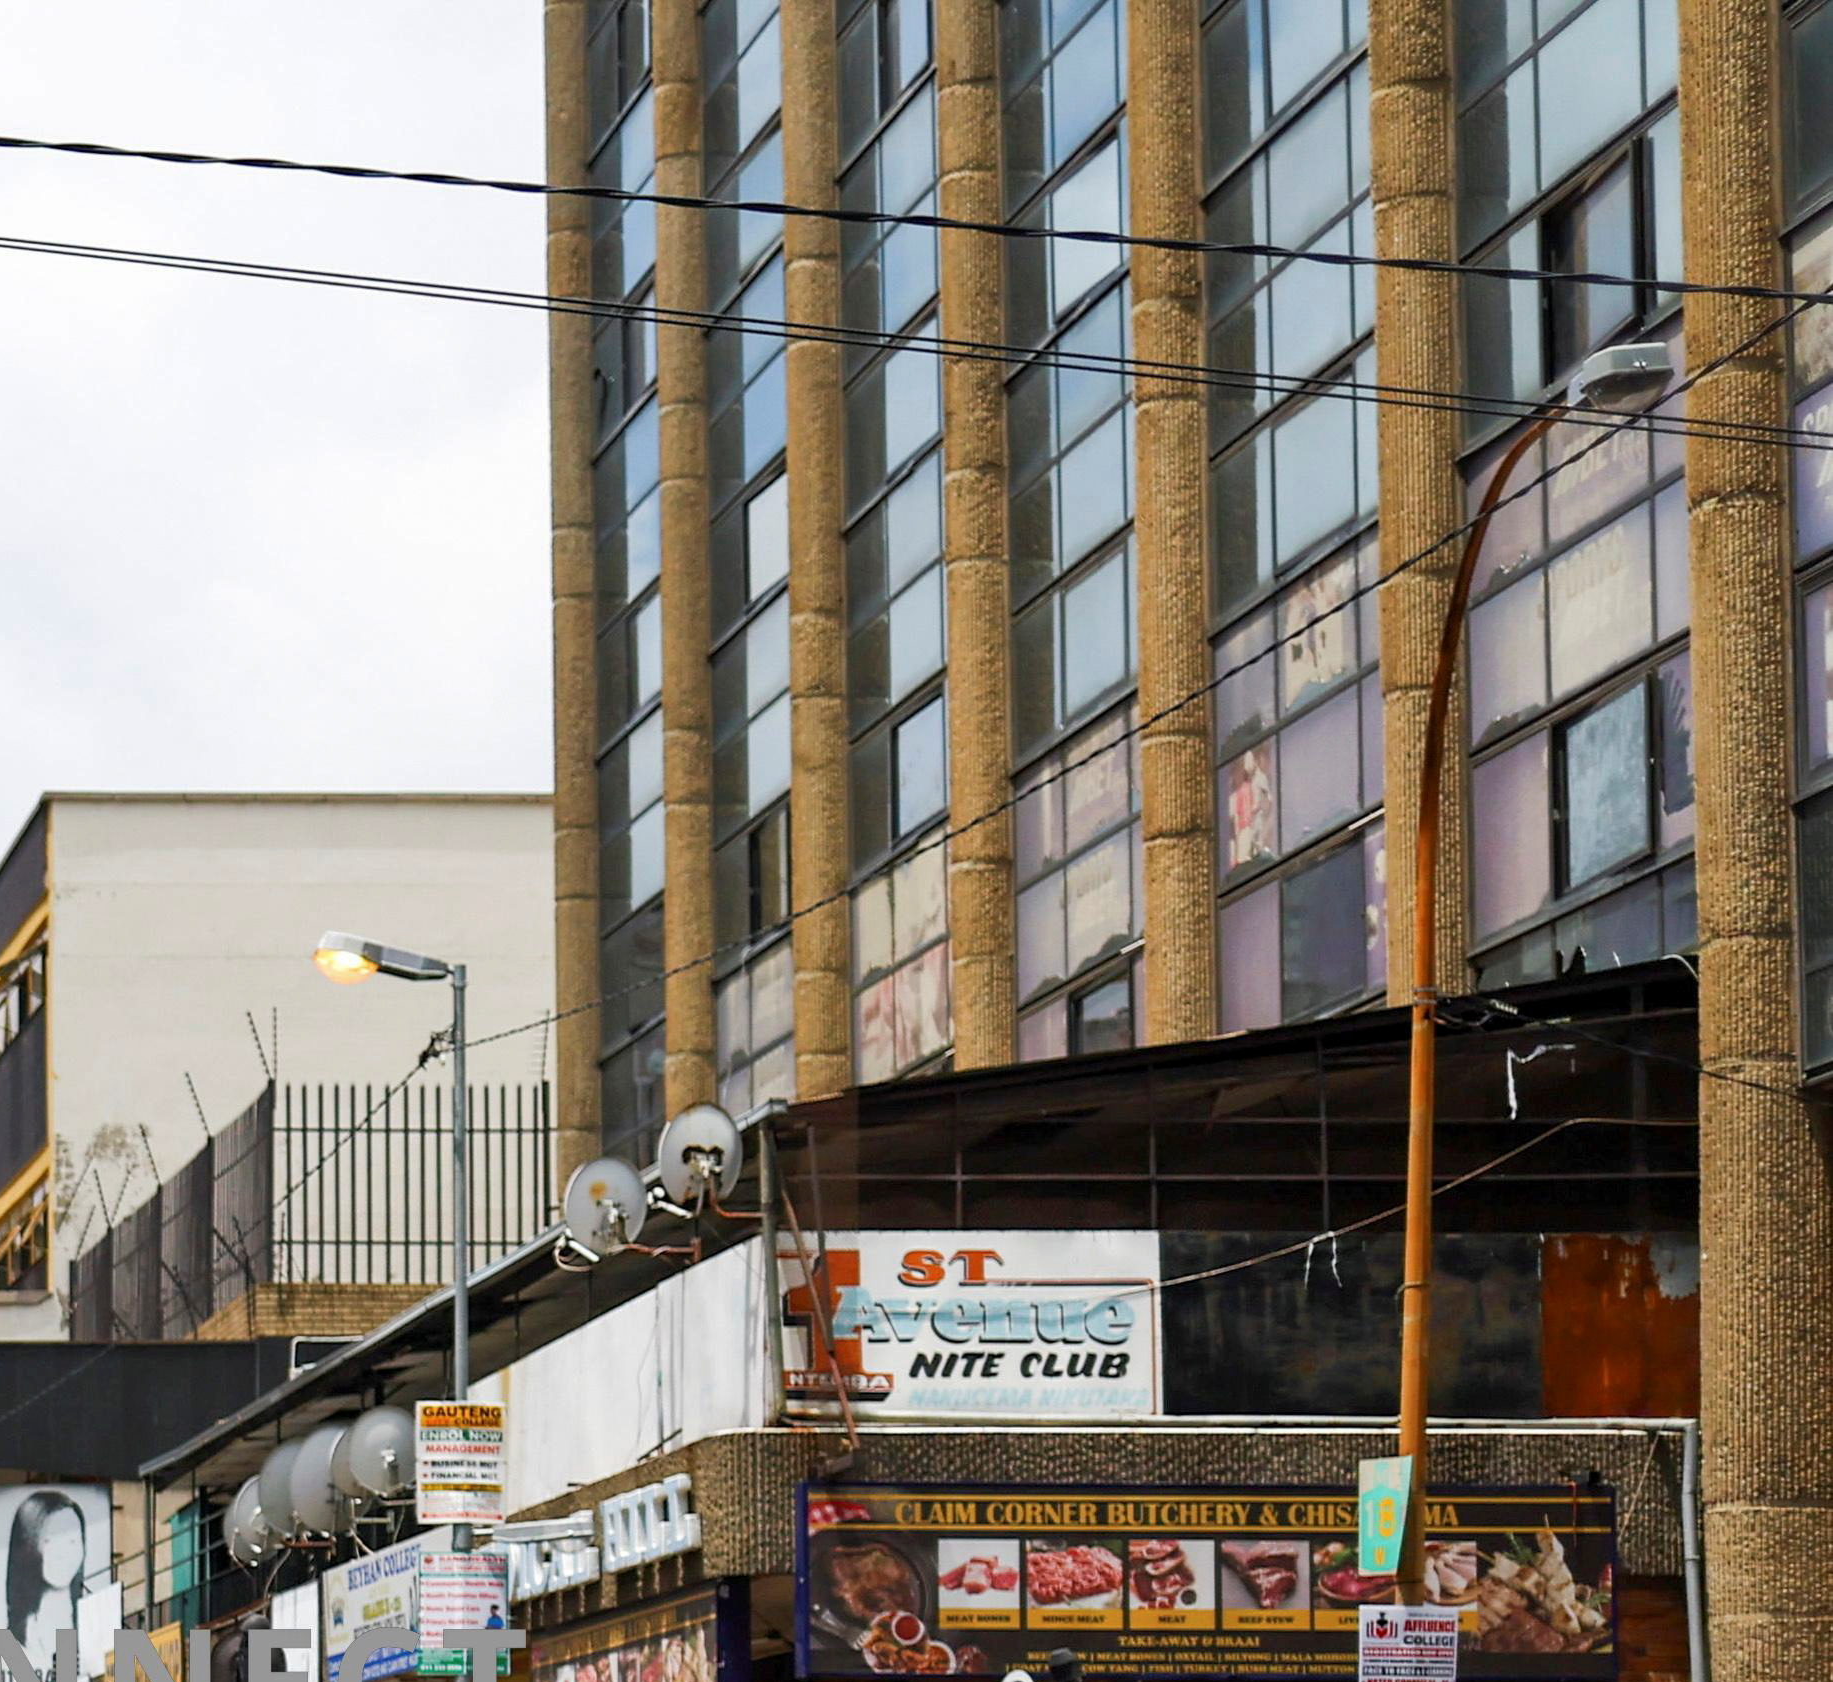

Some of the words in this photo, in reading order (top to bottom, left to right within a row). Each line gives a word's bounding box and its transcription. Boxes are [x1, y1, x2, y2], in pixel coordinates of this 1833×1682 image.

[898, 1250, 1004, 1287] ST
[832, 1287, 1136, 1345] Avenue
[908, 1352, 1006, 1378] NITE
[1020, 1352, 1130, 1378] CLUB
[423, 1406, 501, 1417] GAUTENG
[454, 1418, 501, 1426] COLLEGE
[470, 1431, 502, 1441] NOW
[426, 1445, 501, 1454] MANAGEMENT
[894, 1503, 977, 1527] CLAIM
[998, 1502, 1100, 1527] CORNER
[1107, 1502, 1251, 1527] BUTCHERY
[1262, 1503, 1279, 1526] &
[945, 1613, 974, 1625] MEAT
[1157, 1614, 1188, 1625] MEAT
[1404, 1619, 1456, 1633] AFFLUENCE
[1117, 1636, 1199, 1647] TAKE-AWAY
[1216, 1636, 1260, 1648] BRAAI
[1404, 1635, 1454, 1646] COLLEGE
